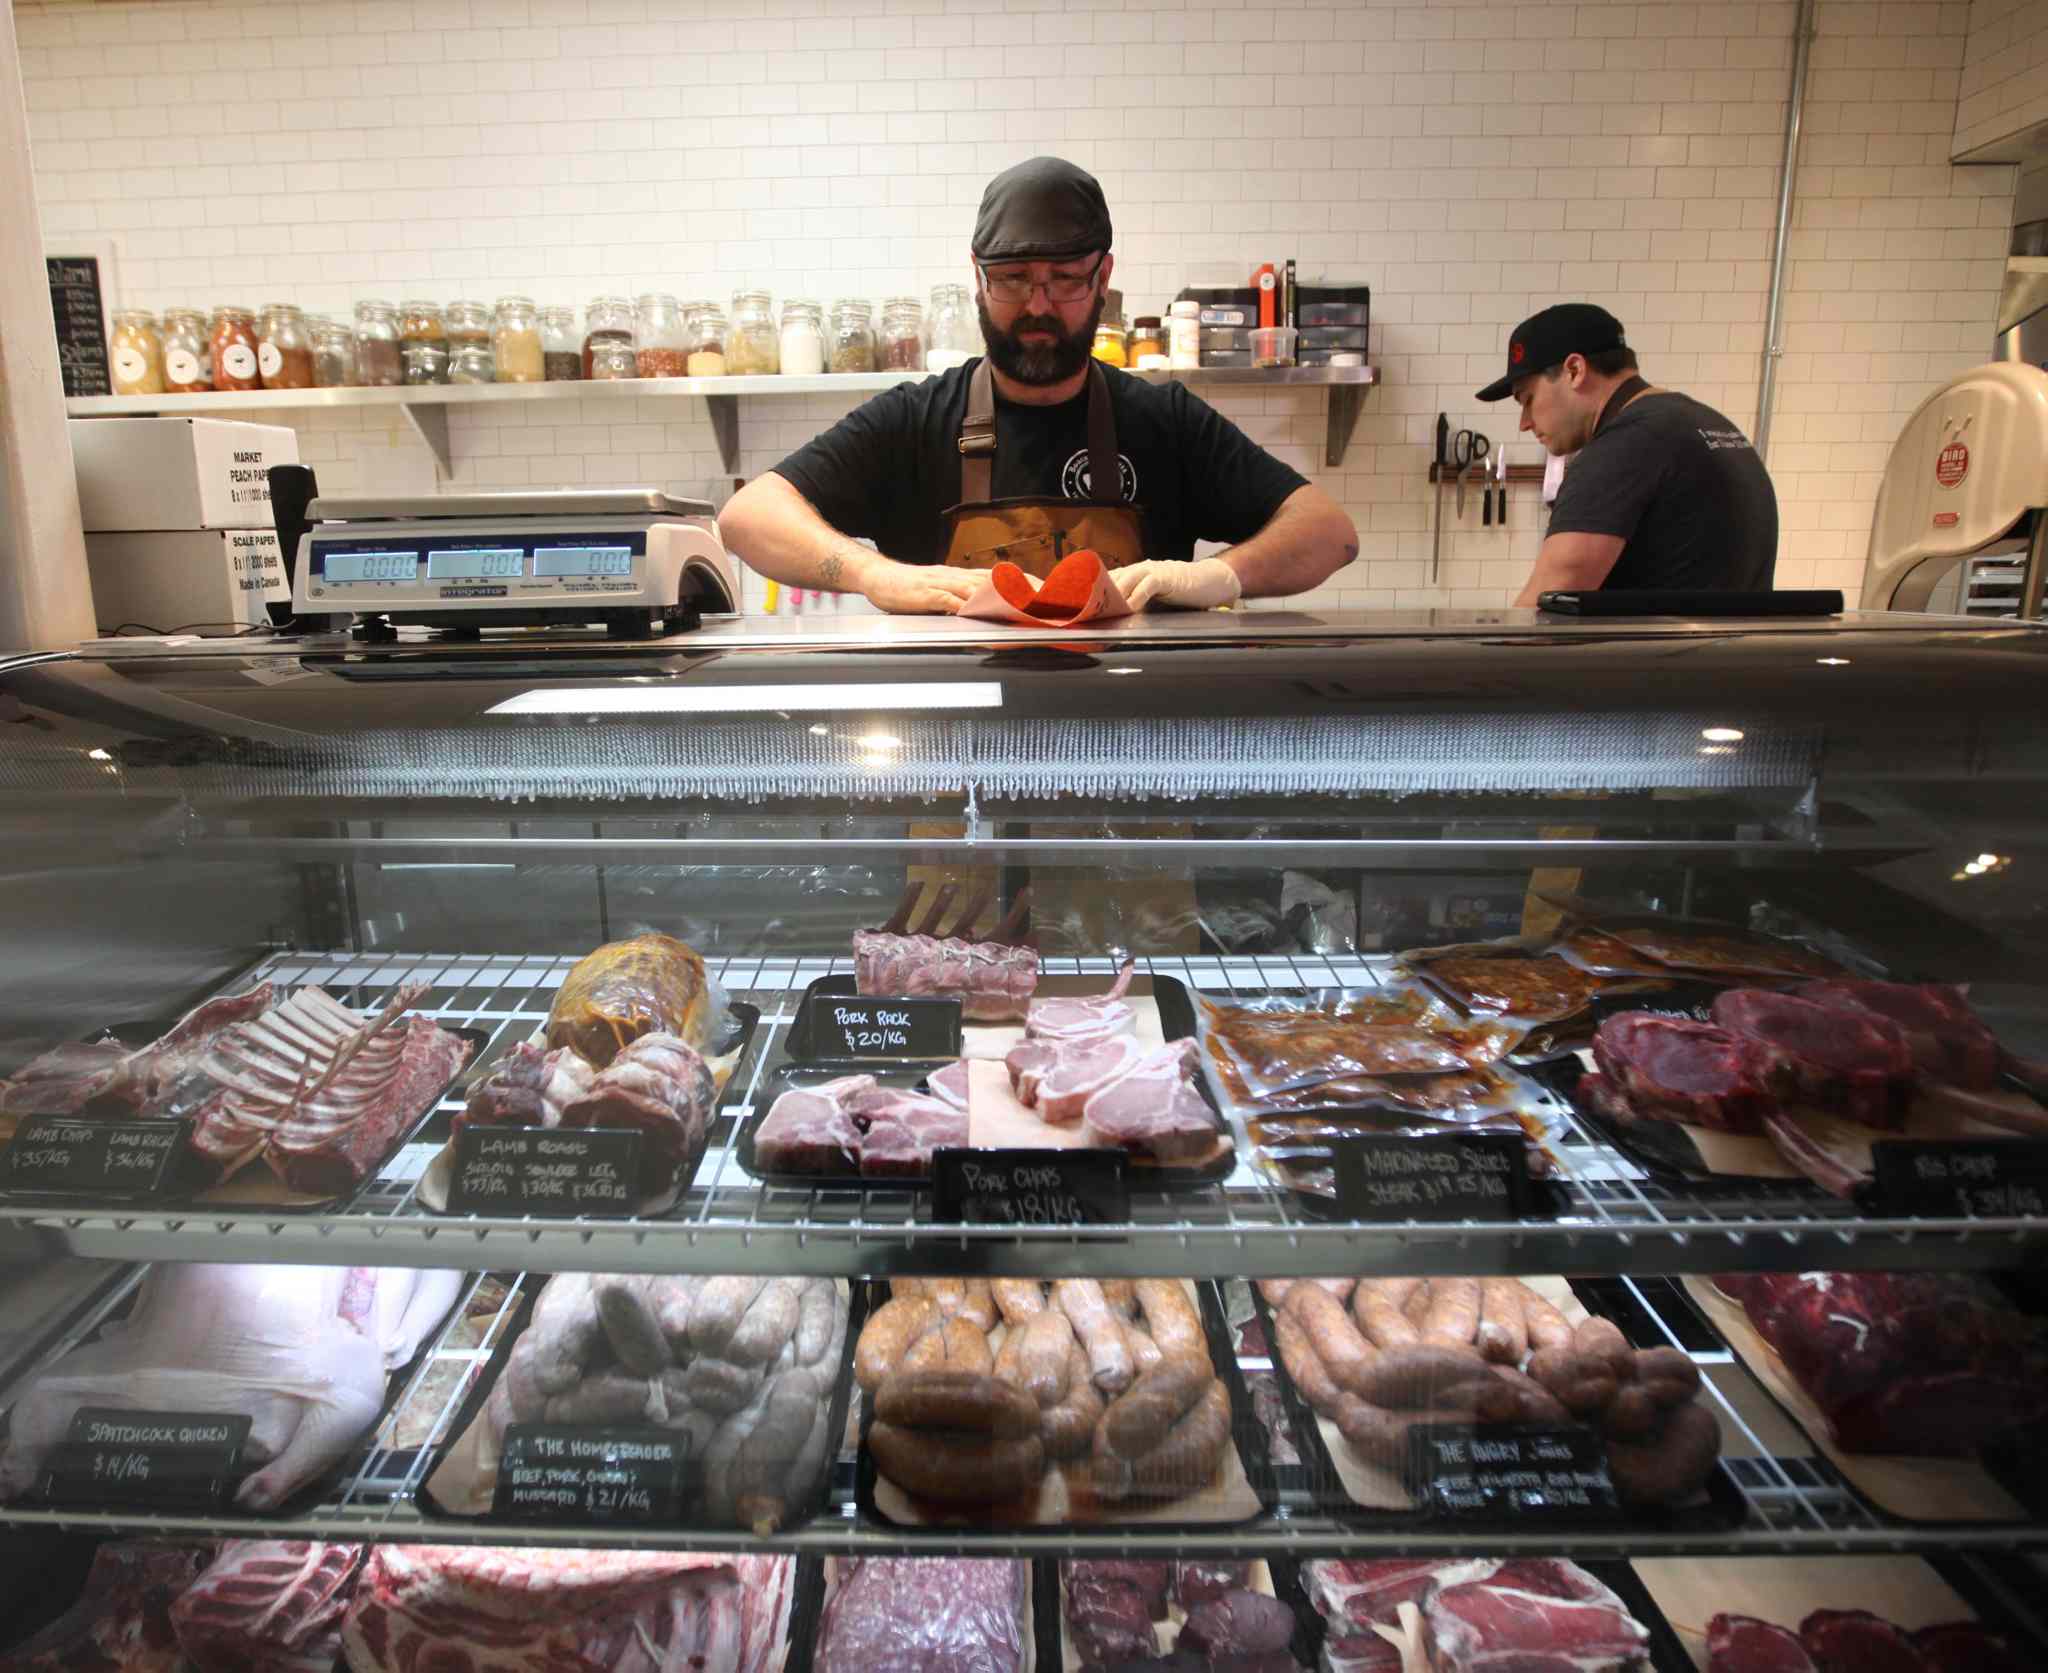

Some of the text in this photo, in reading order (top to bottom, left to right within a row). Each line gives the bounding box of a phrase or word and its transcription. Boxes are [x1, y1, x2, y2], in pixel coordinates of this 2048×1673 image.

[234, 451, 263, 463] MARKET
[230, 470, 252, 482] PEACH
[233, 535, 276, 547] SCALE PAPER
[876, 1009, 912, 1027] RACK
[480, 1139, 528, 1156] LAMB
[534, 1437, 564, 1457] THE
